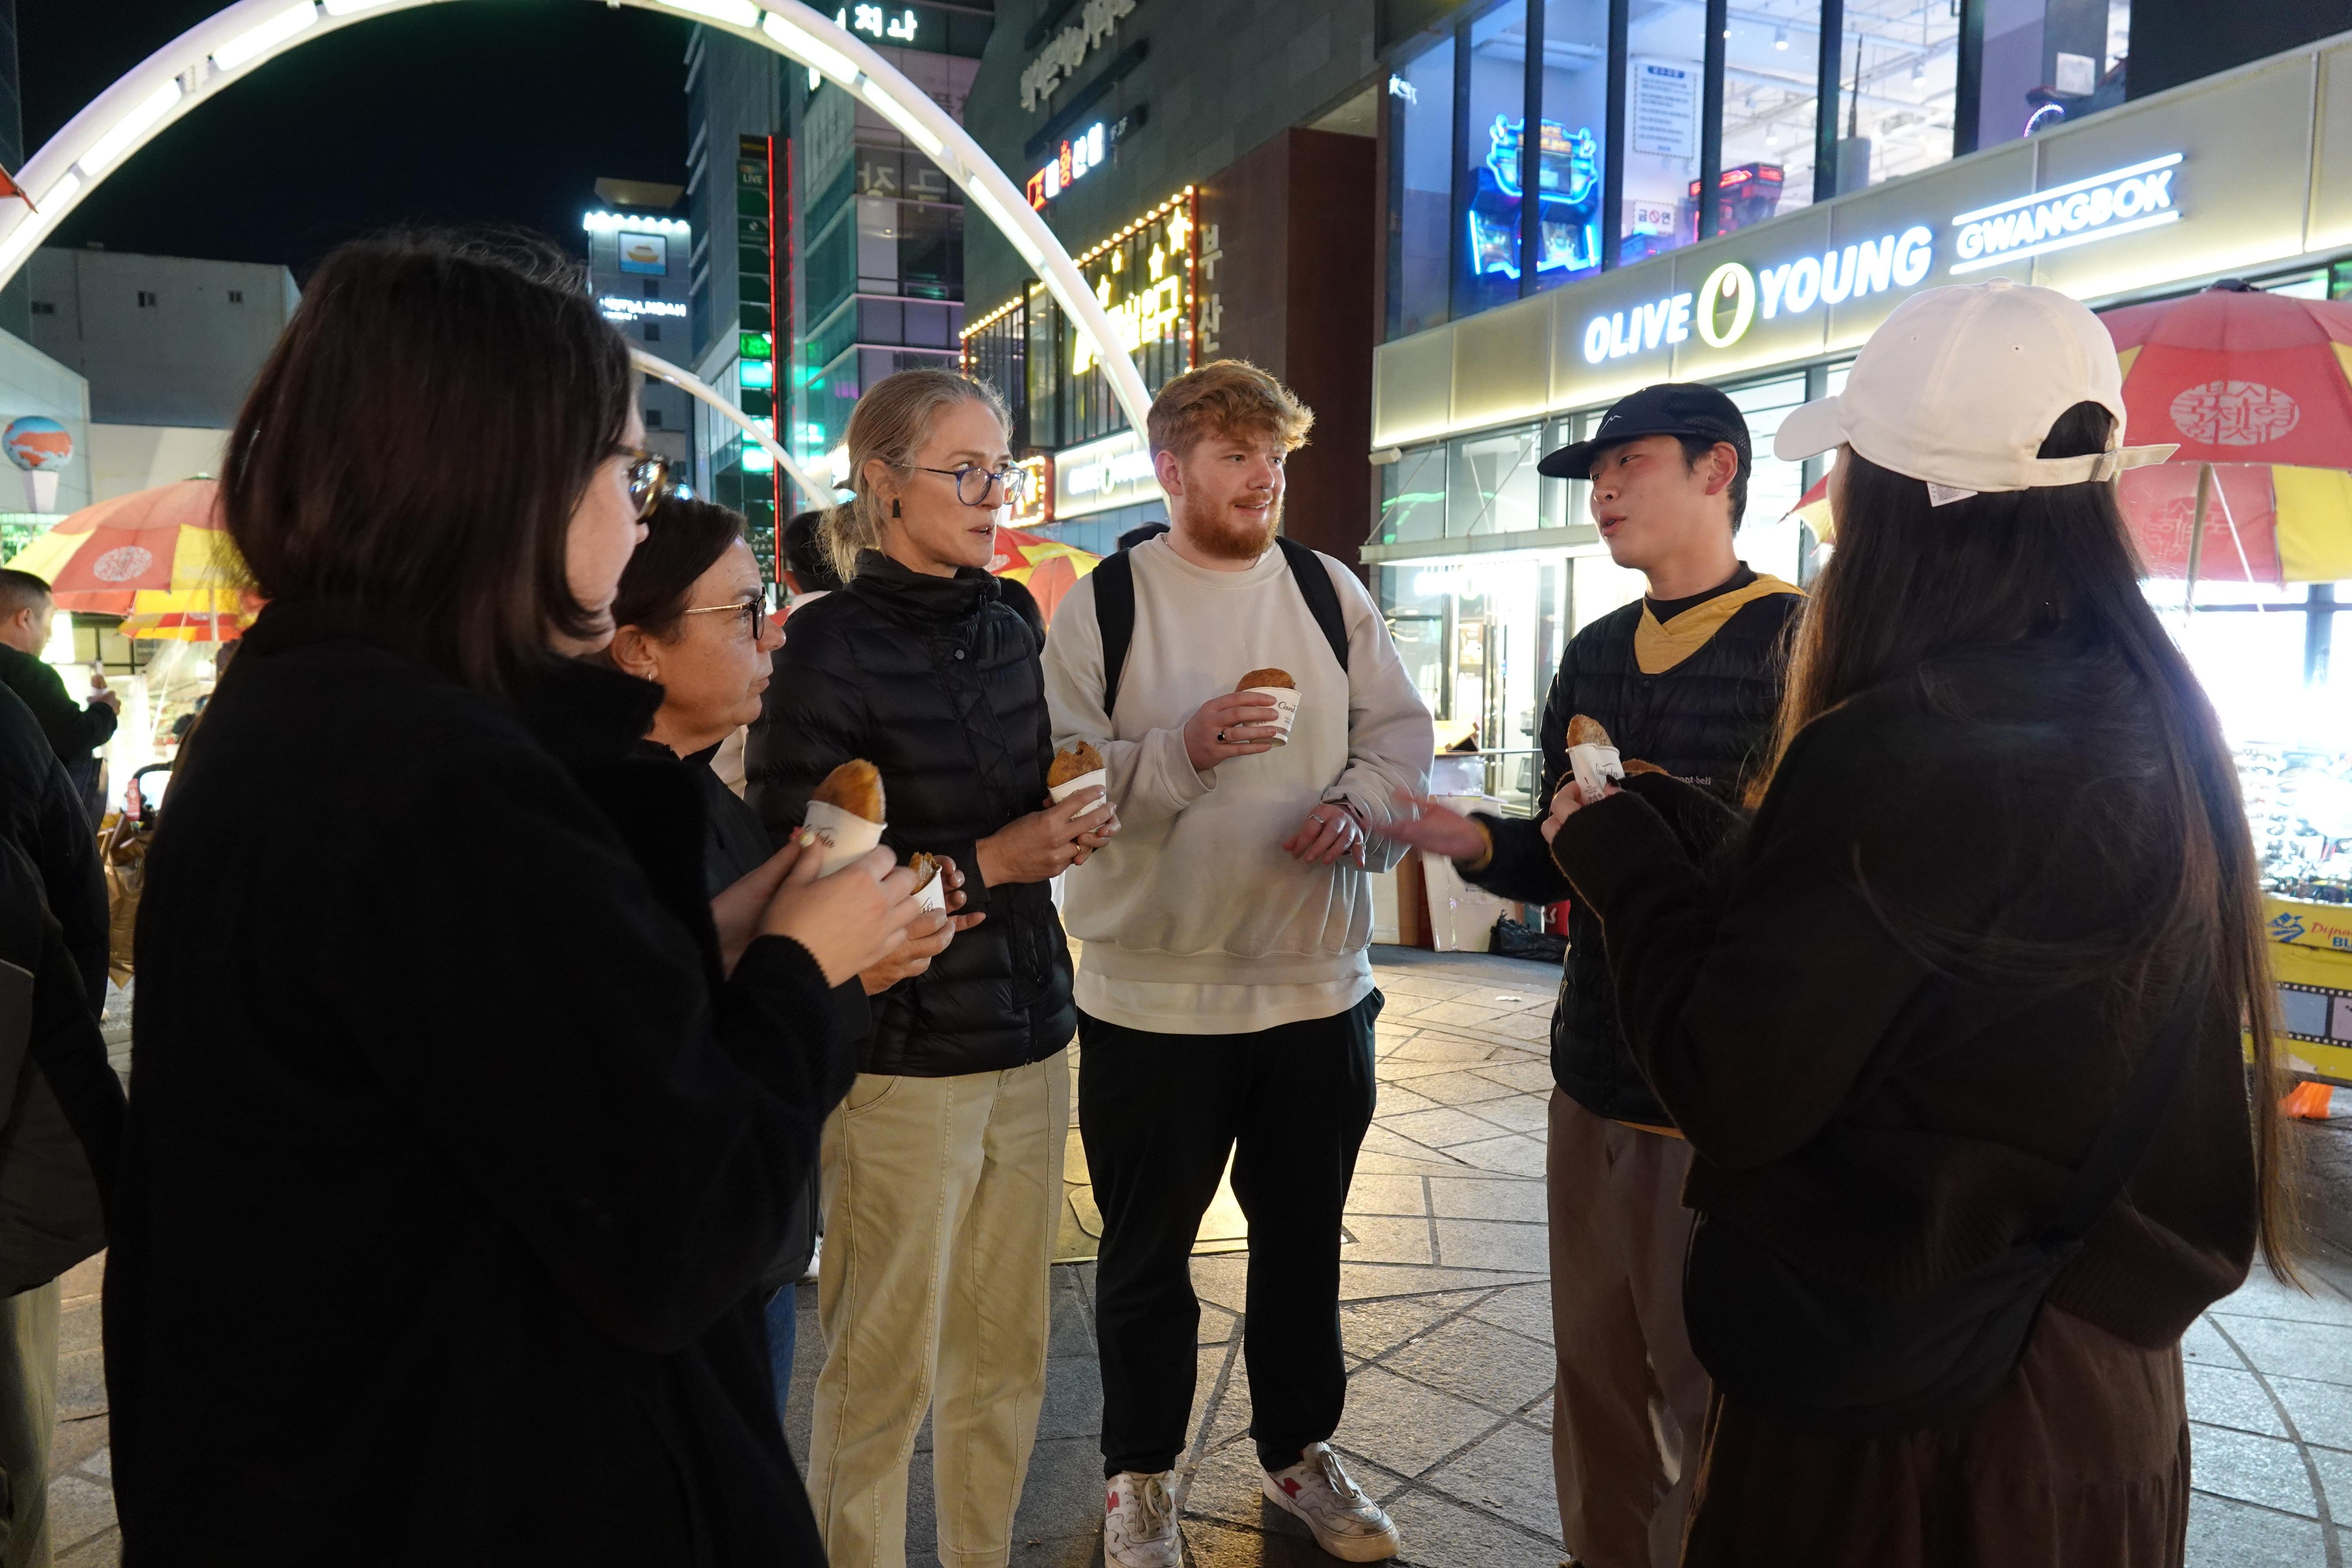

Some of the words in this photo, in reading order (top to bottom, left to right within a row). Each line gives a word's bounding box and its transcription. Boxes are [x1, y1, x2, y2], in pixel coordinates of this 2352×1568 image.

[1957, 170, 2174, 254] GWANGBOK
[1198, 224, 1223, 354] 부산
[1584, 292, 1693, 364] OLIVE
[1758, 225, 1933, 320] YOUNG
[1678, 776, 1711, 785] ont-bell
[2311, 922, 2352, 940] Dyna
